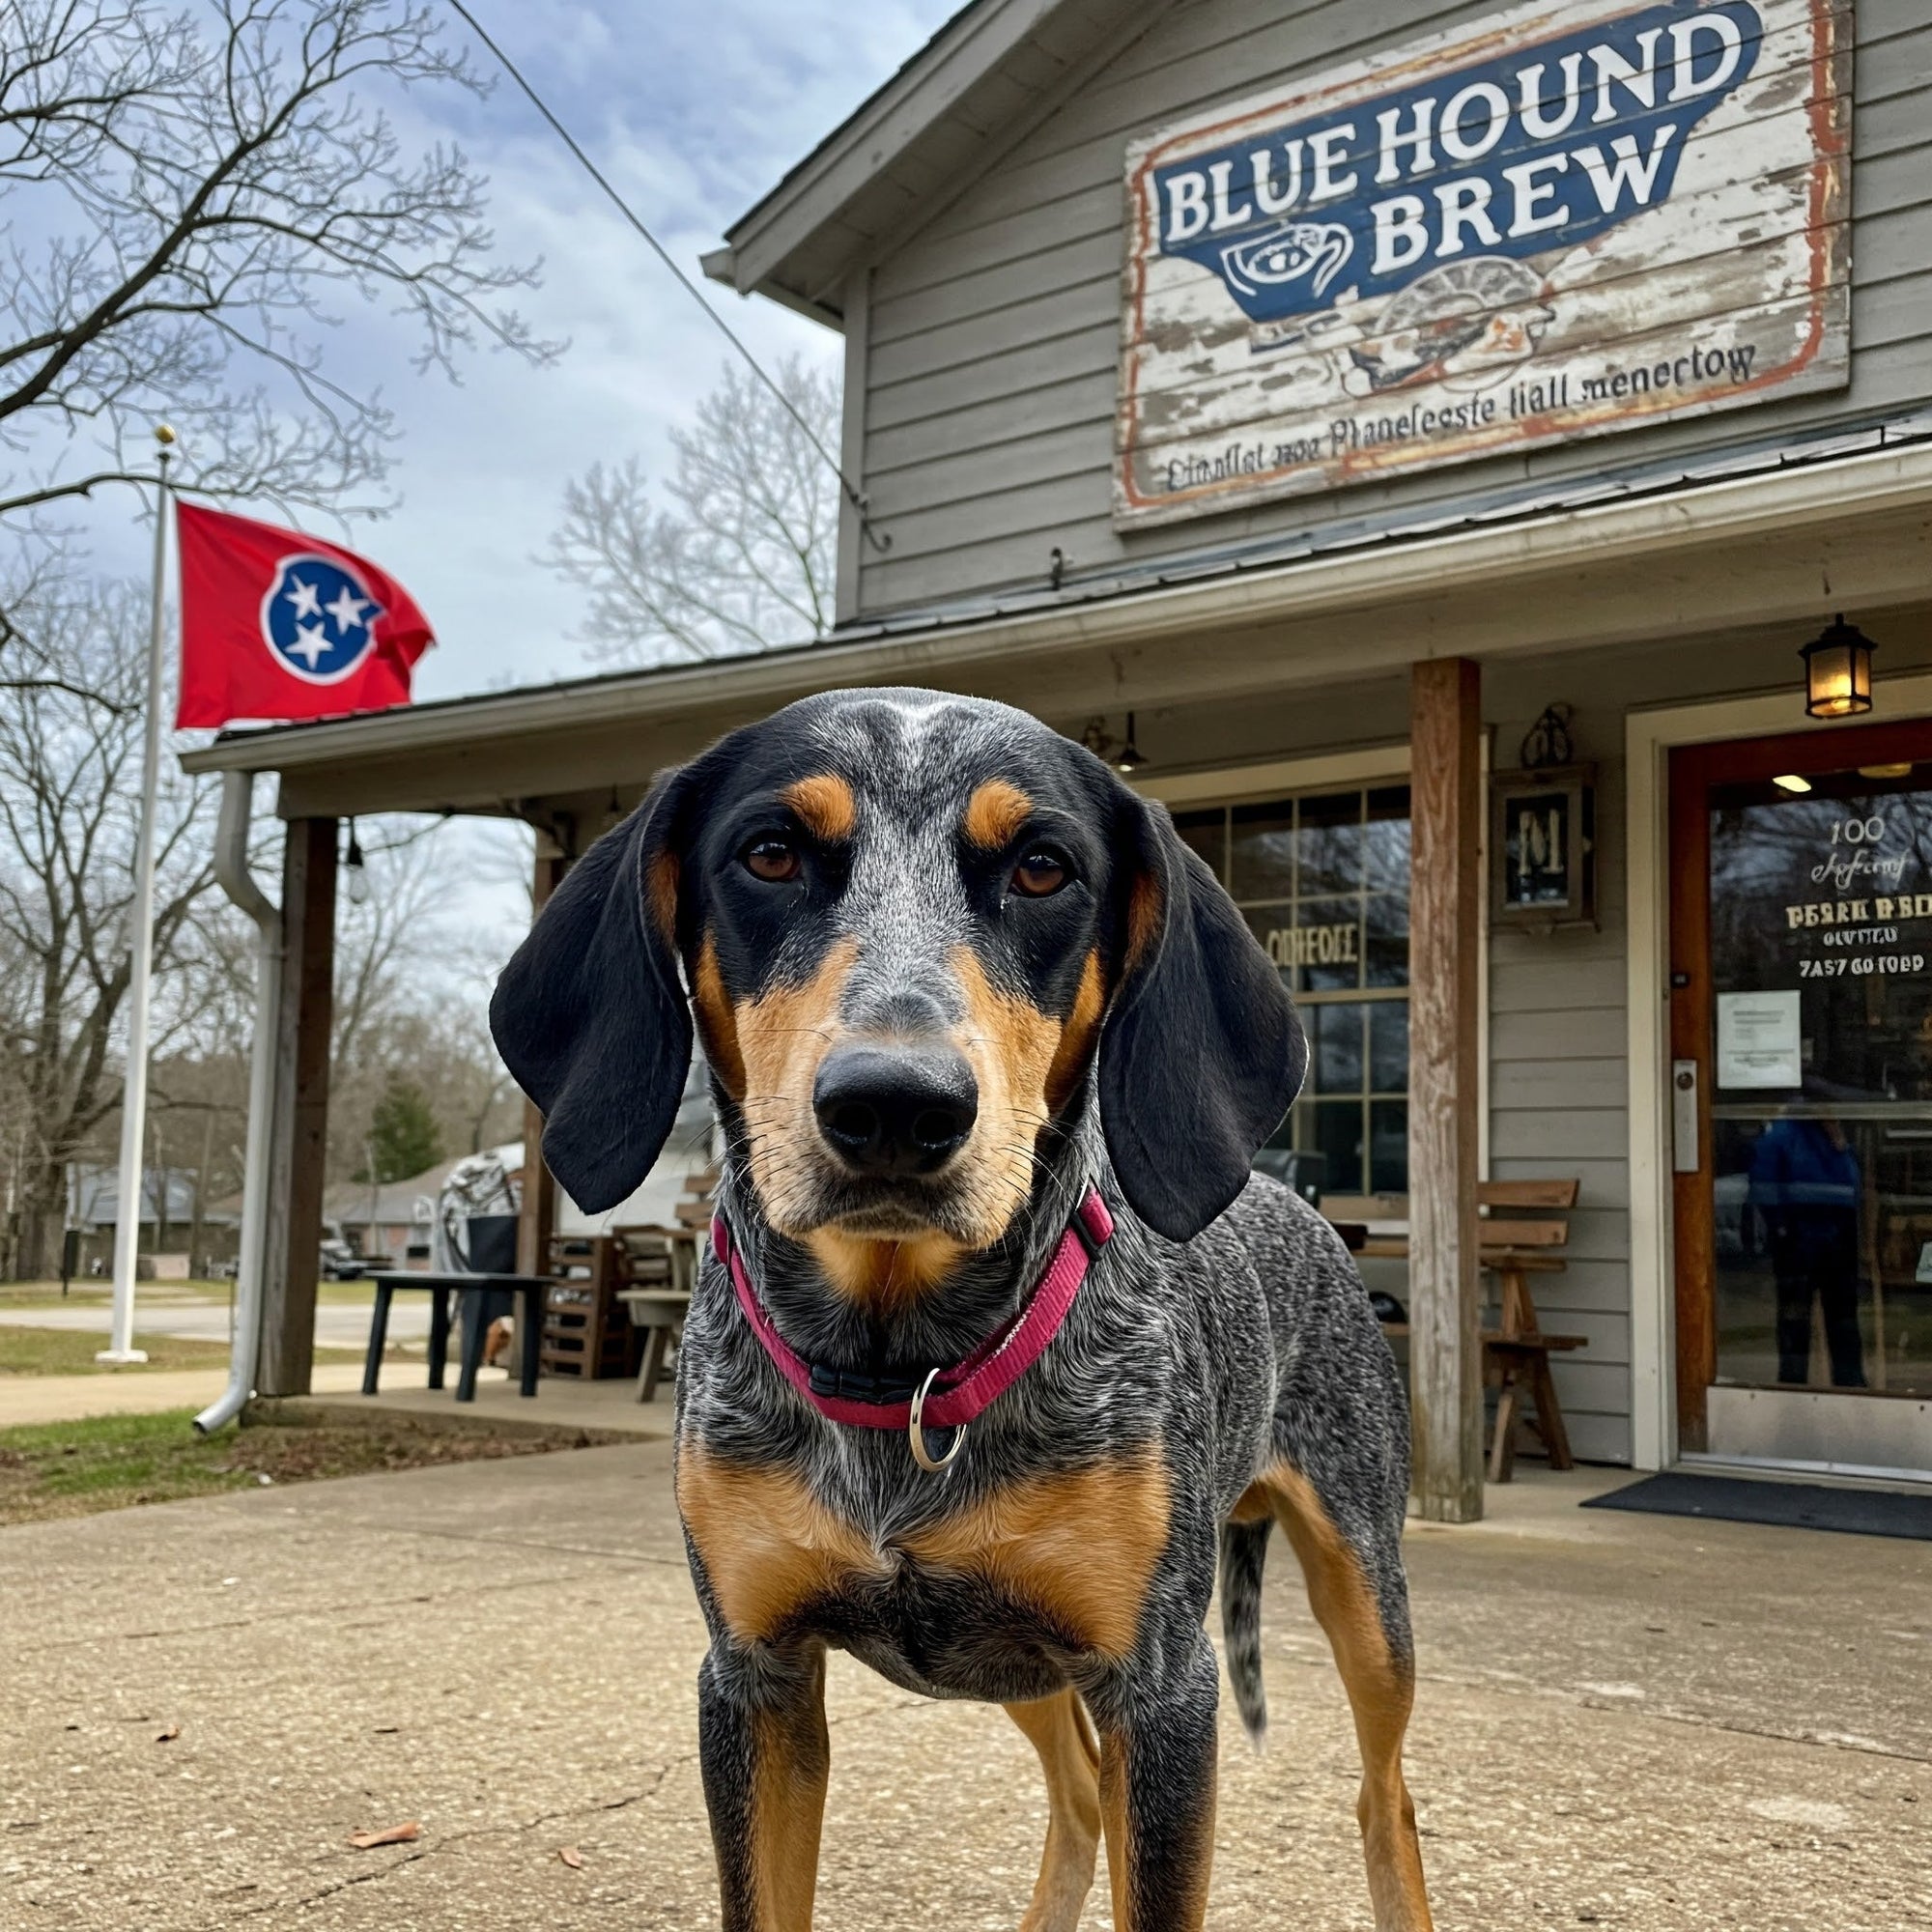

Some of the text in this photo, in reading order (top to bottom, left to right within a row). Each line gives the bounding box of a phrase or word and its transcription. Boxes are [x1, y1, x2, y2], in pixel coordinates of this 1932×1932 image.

[1165, 13, 1743, 243] BLUE HOUND
[1370, 124, 1678, 276] BREW
[1831, 816, 1885, 845] 100
